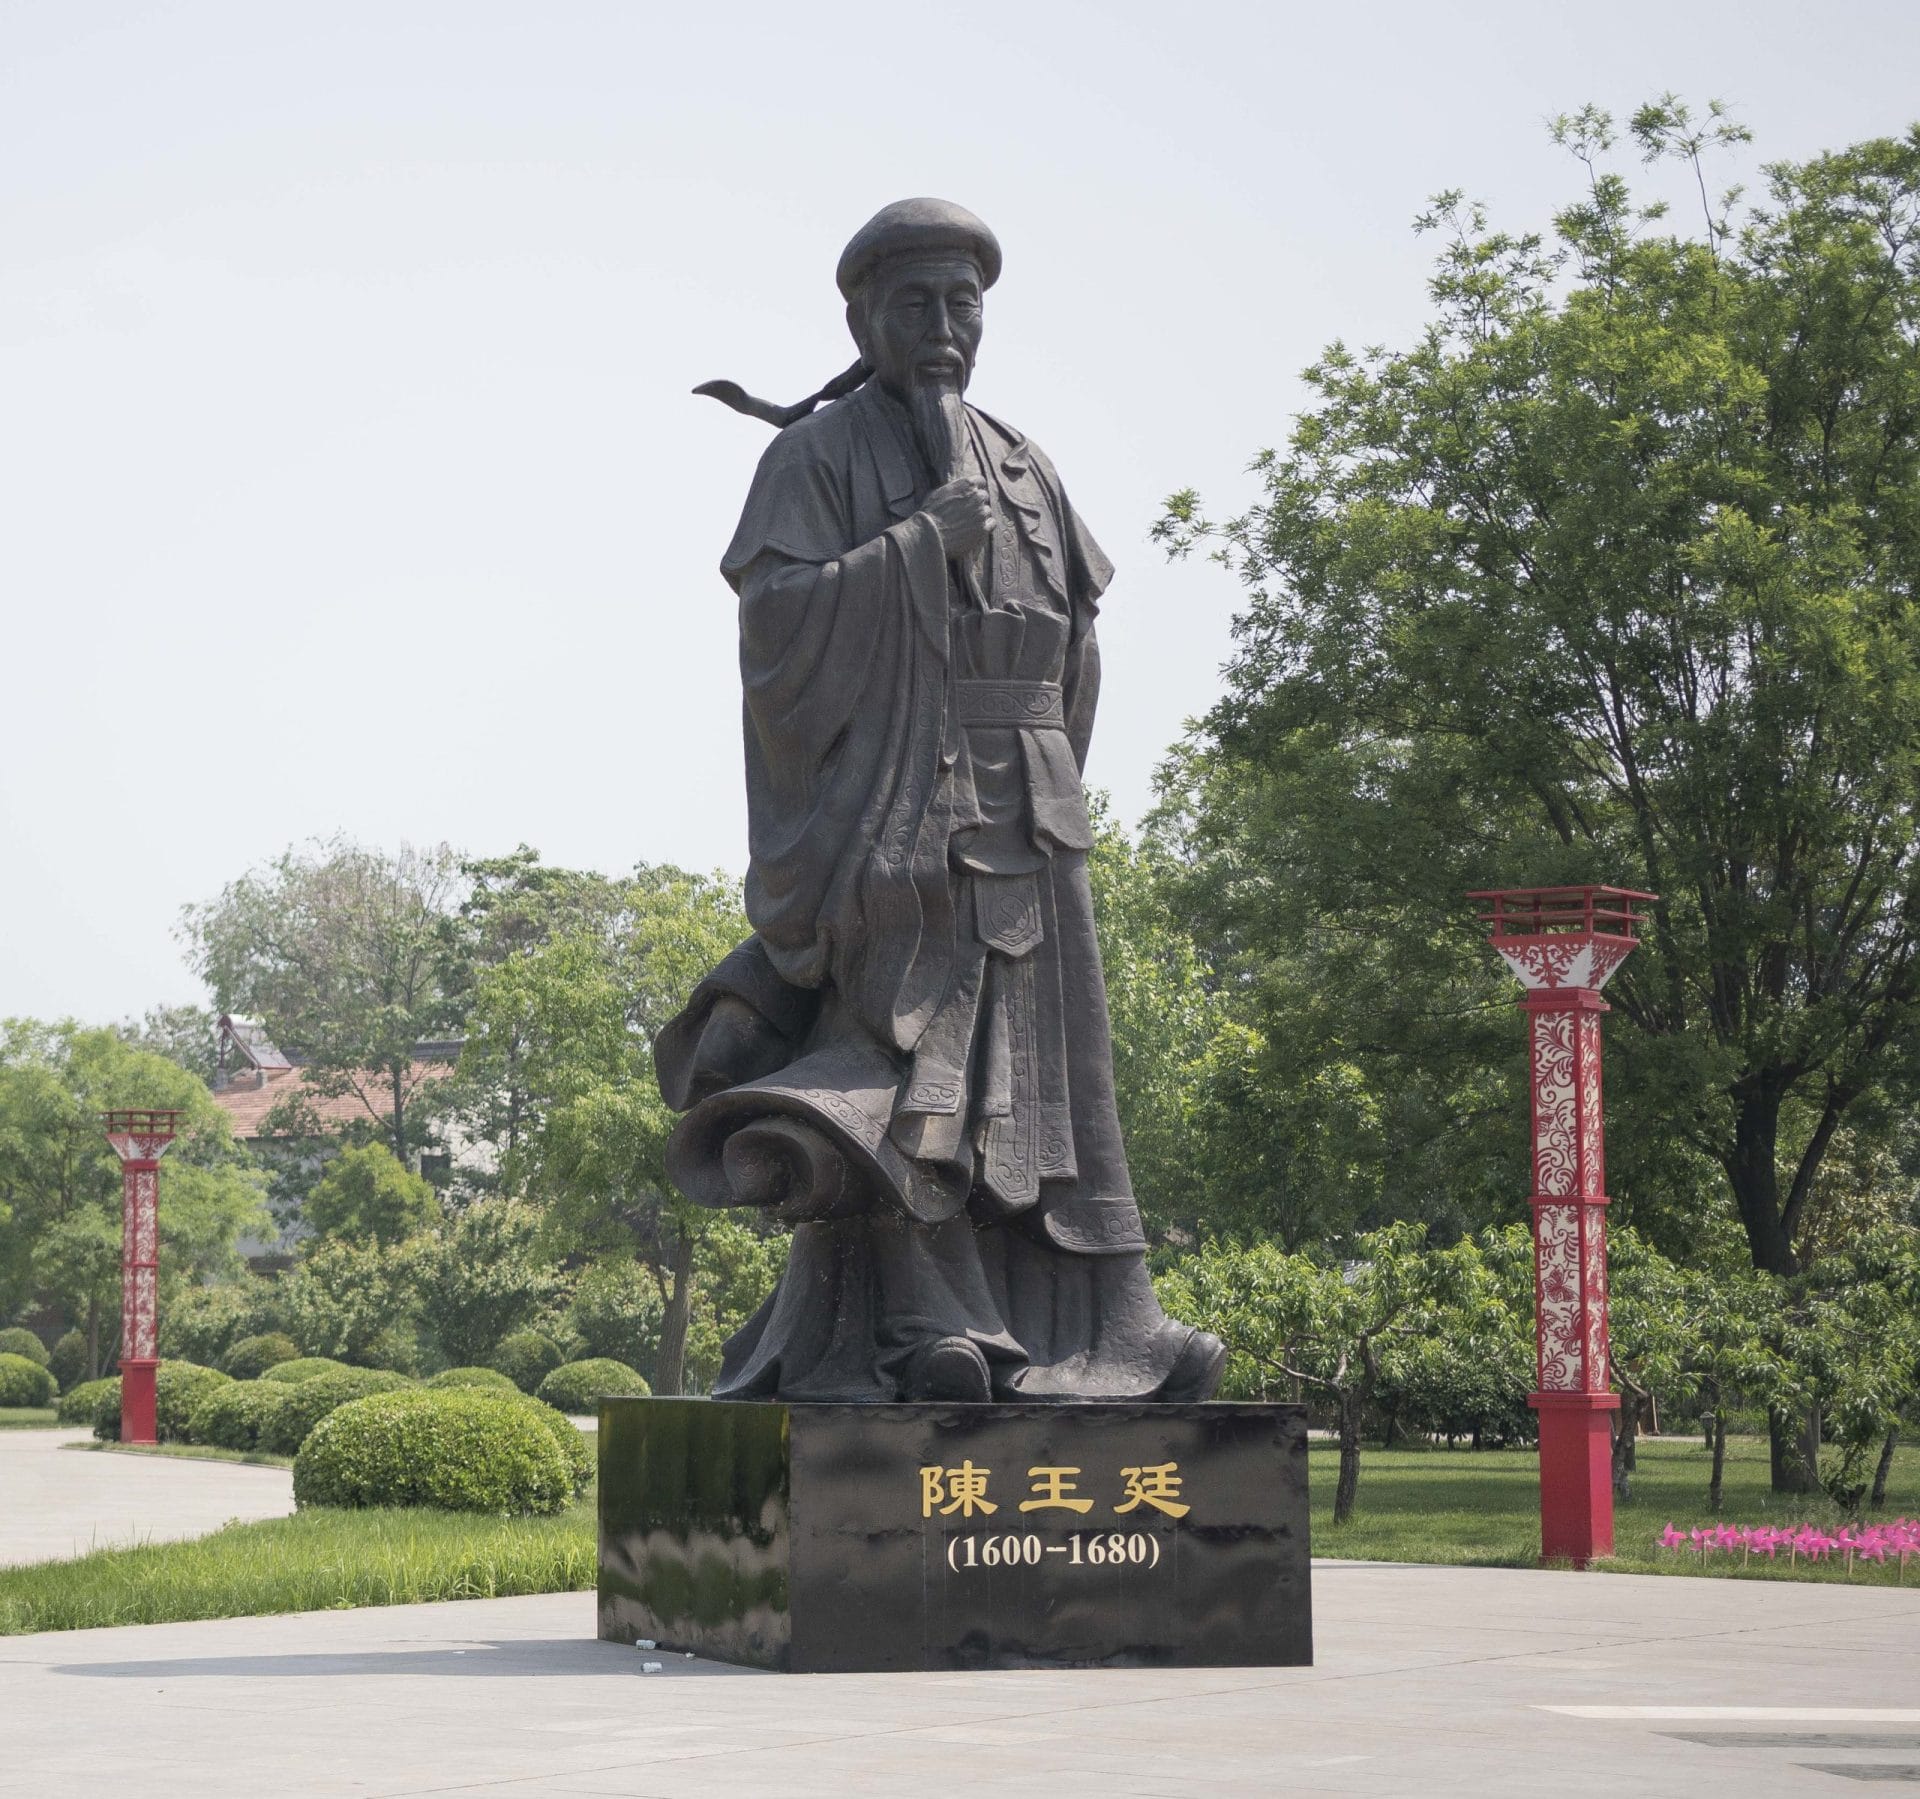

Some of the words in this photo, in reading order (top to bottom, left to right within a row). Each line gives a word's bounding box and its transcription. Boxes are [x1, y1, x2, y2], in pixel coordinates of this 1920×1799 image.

[919, 1459, 1191, 1518] 陳王廷
[948, 1533, 1159, 1572] (1600-1680)
